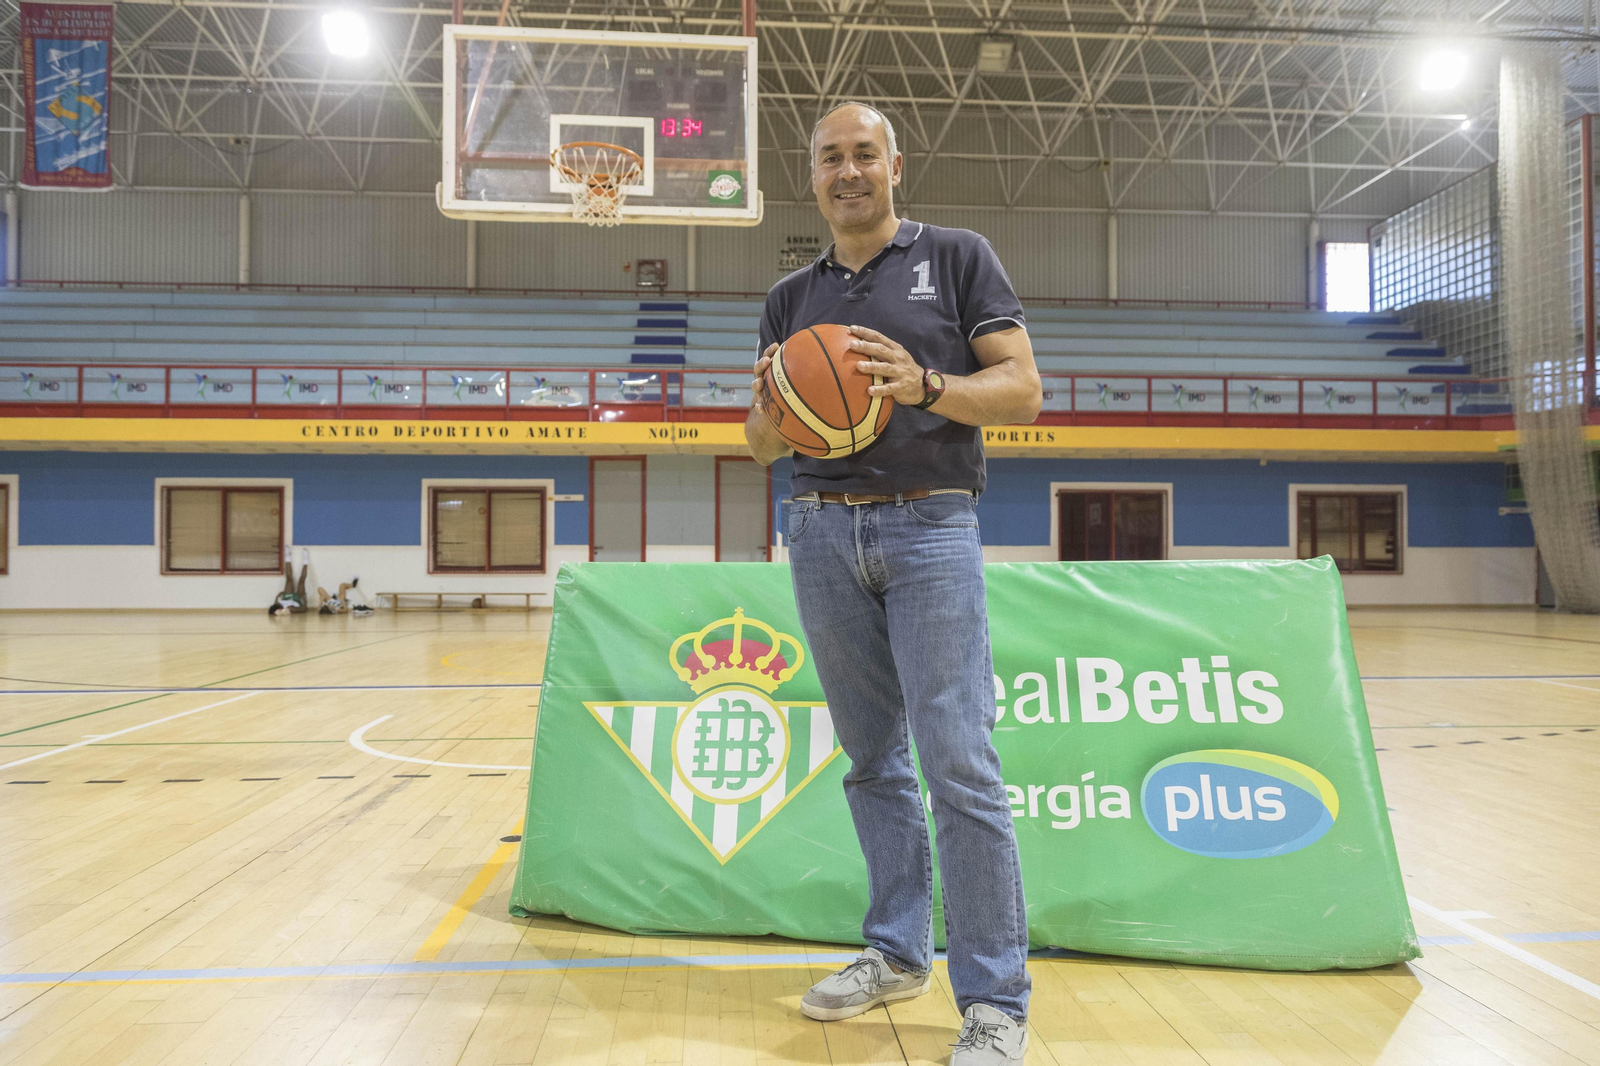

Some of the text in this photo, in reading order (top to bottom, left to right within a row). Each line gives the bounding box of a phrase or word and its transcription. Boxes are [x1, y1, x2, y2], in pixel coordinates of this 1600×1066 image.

[911, 260, 936, 294] 1
[39, 382, 60, 392] IMD
[127, 383, 147, 393] IMD
[213, 383, 233, 393] IMD
[299, 383, 319, 394] IMD
[384, 384, 404, 394] IMD
[469, 385, 488, 395] IMD
[551, 385, 570, 395] IMD
[721, 387, 736, 395] IMD
[1113, 392, 1131, 402] IMD
[1188, 393, 1206, 402] IMD
[1264, 394, 1281, 403] IMD
[1338, 395, 1356, 404] IMD
[1412, 395, 1429, 405] IMD
[301, 425, 588, 439] CENTRO DEPORTIVO AMATE
[985, 430, 1056, 443] PORTES
[1163, 774, 1287, 832] plus
